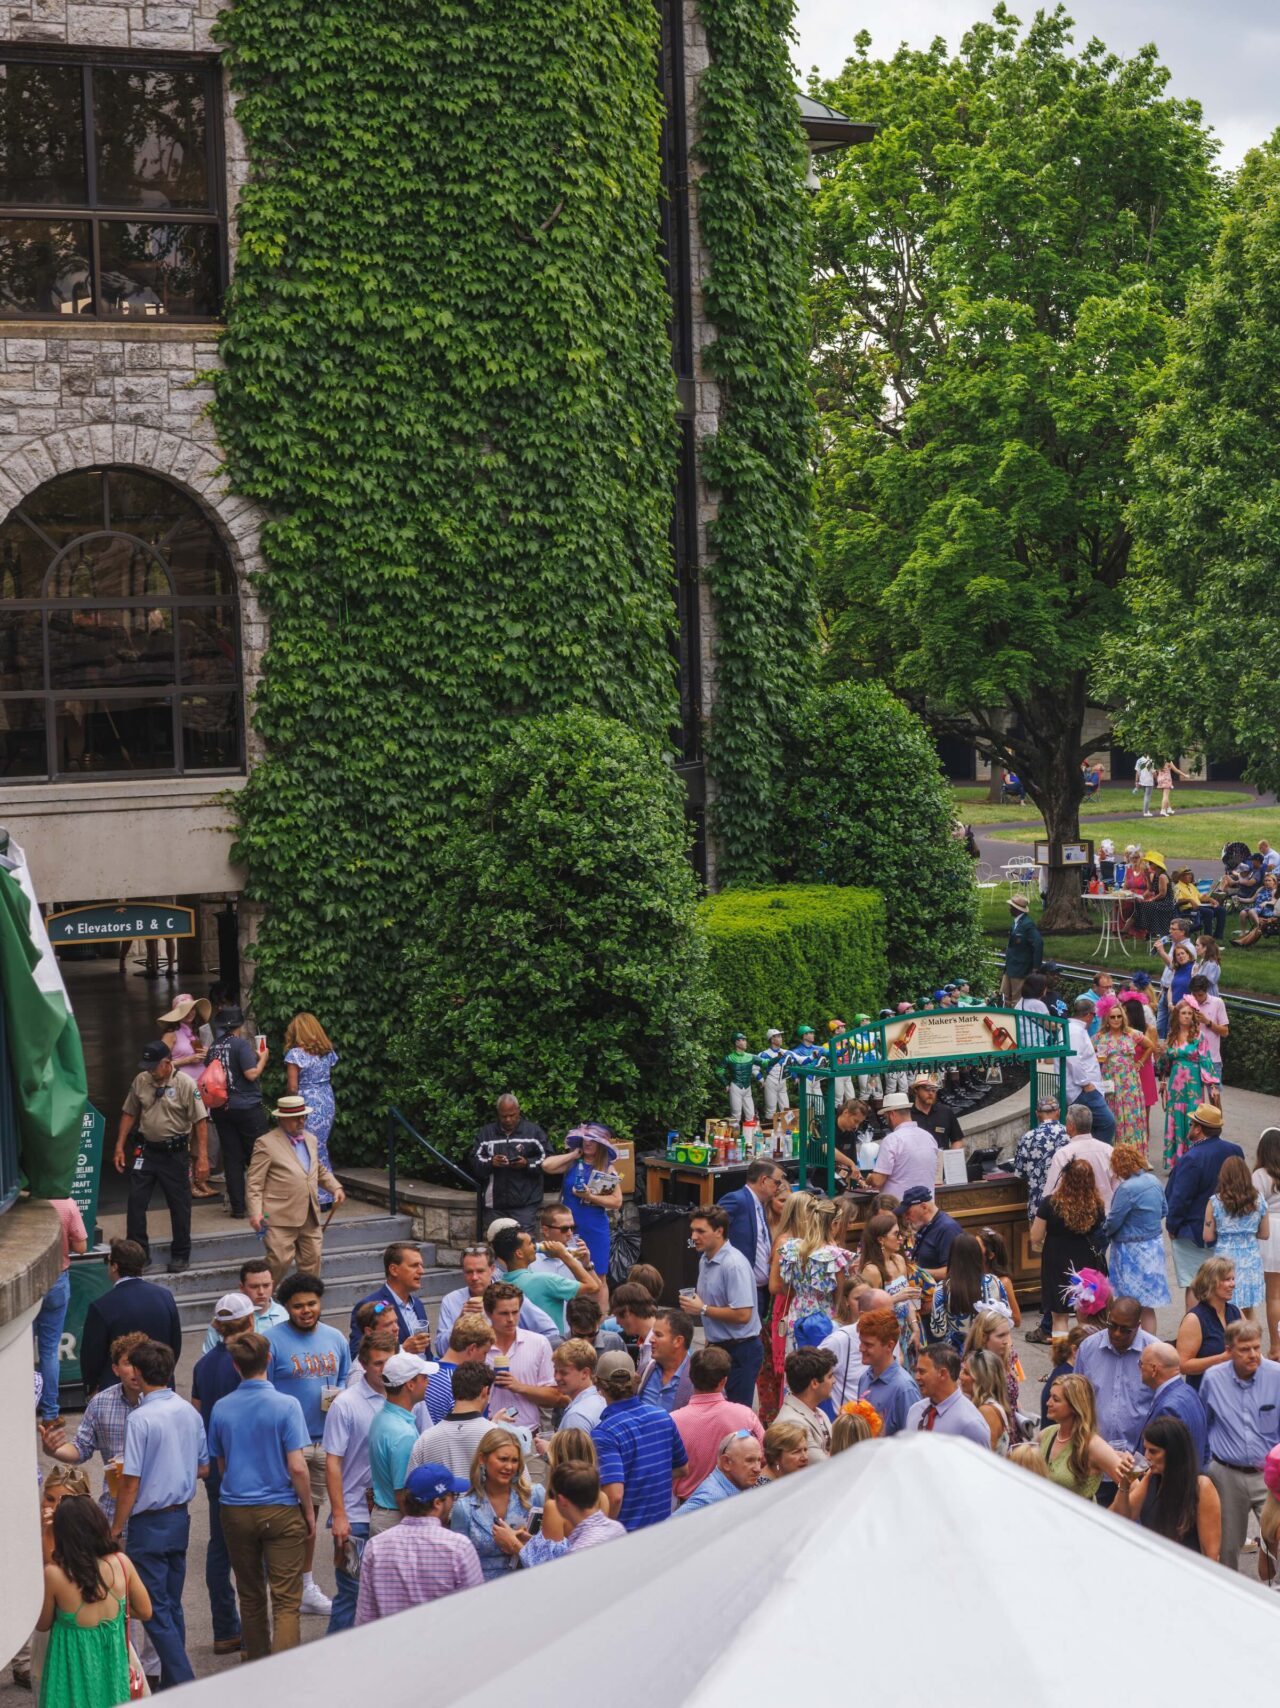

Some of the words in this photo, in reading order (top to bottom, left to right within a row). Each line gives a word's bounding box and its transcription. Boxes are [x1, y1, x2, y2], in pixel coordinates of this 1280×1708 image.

[77, 922, 131, 934] Elevators
[136, 920, 144, 931] B
[150, 919, 159, 930] &
[166, 918, 174, 928] C
[928, 1017, 957, 1025] Maker's
[958, 1015, 979, 1023] Mark
[979, 1053, 1021, 1070] Mark
